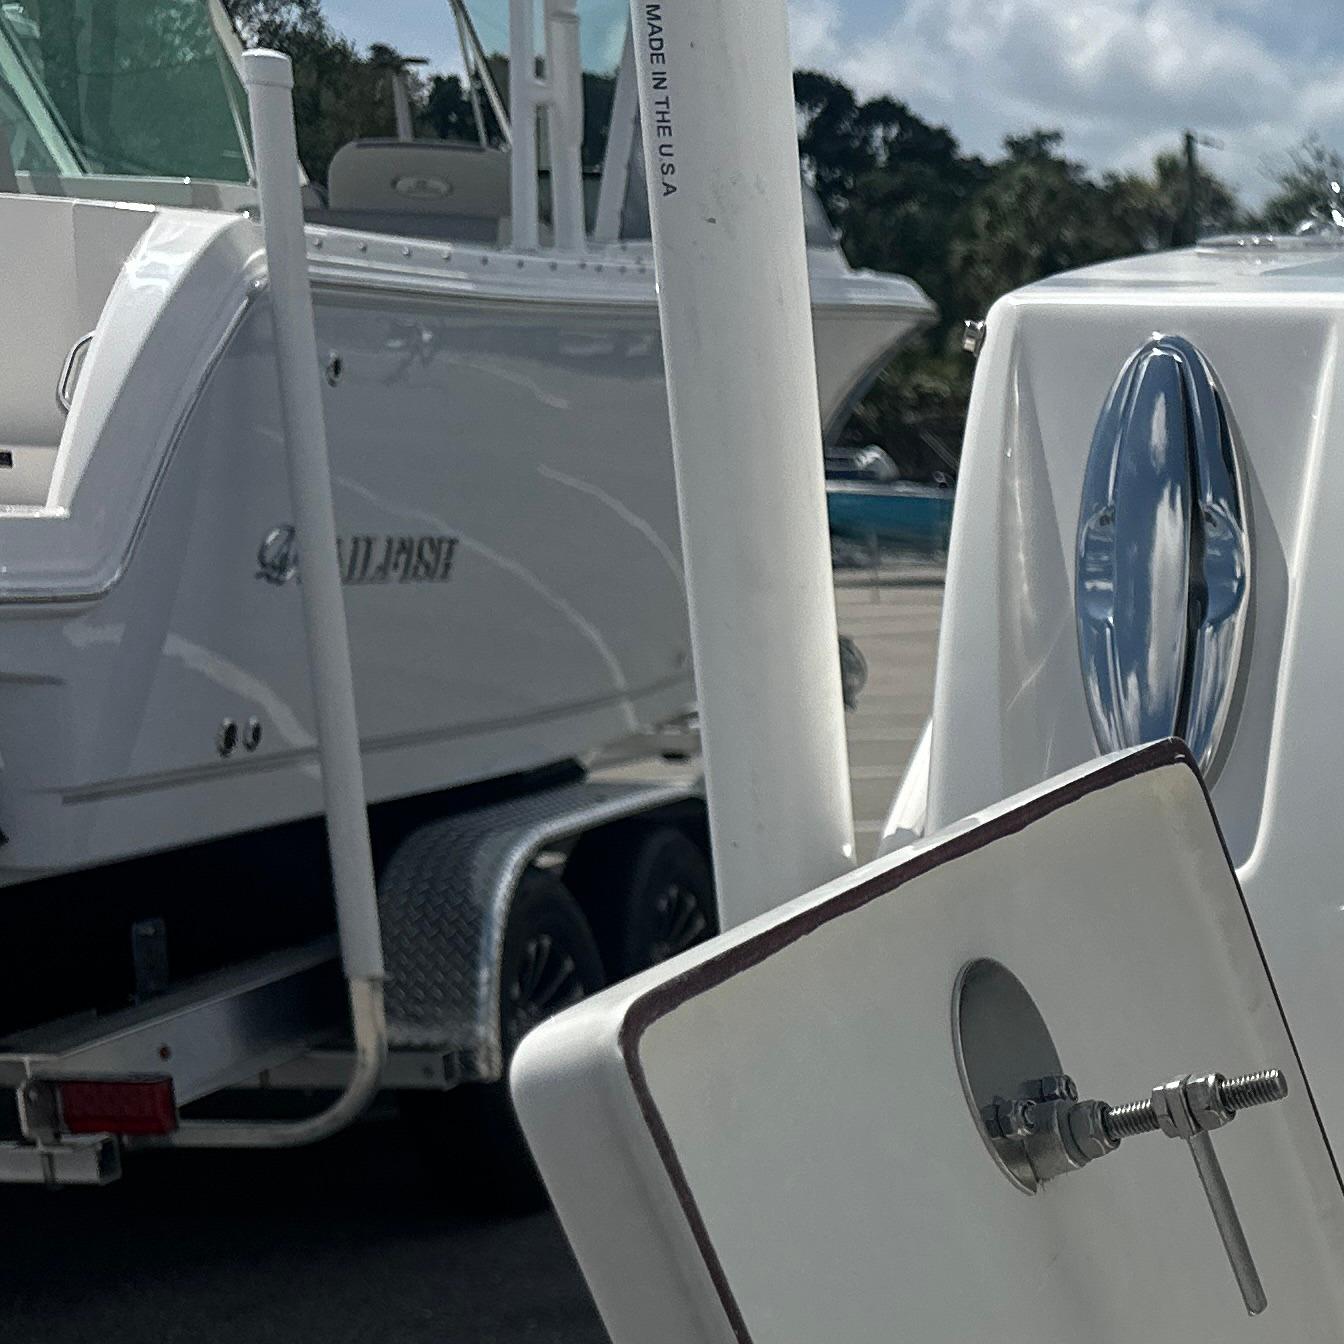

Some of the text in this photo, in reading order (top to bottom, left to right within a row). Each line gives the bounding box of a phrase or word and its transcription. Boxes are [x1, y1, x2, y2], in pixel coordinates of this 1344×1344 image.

[645, 4, 666, 65] MADE
[652, 71, 668, 90] IN
[655, 96, 673, 138] THE
